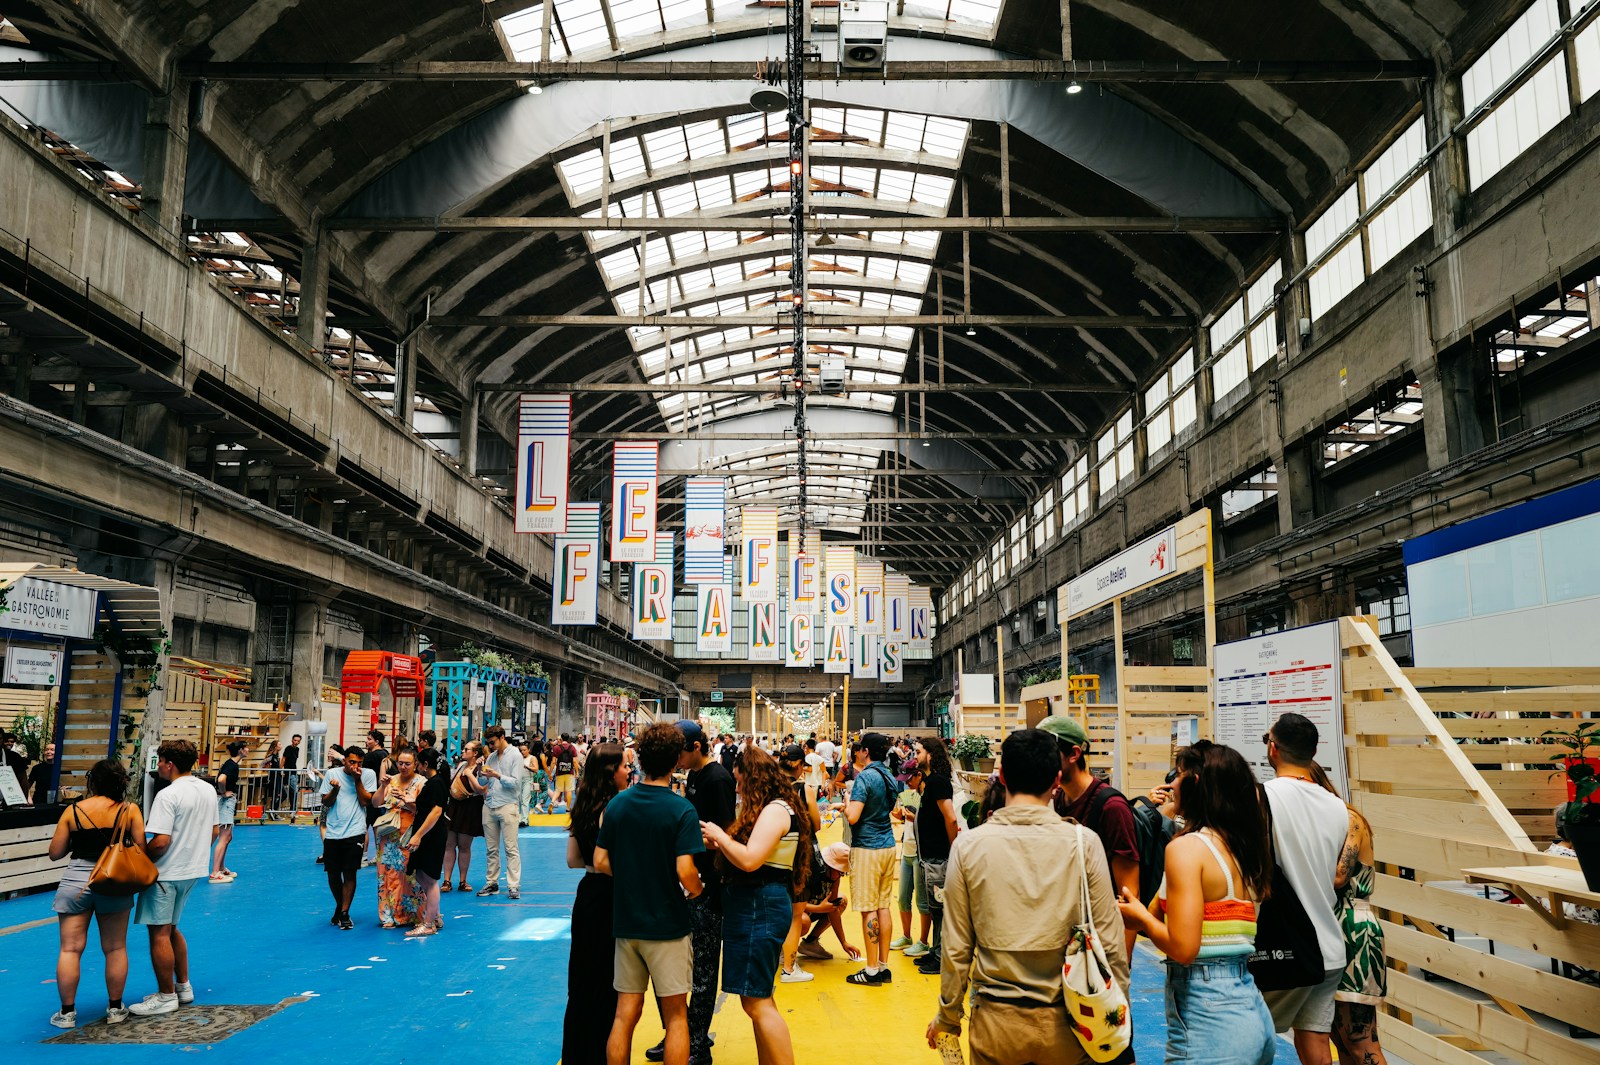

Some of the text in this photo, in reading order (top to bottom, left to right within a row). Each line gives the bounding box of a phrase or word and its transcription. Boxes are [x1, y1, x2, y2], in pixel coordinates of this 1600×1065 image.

[526, 441, 556, 511] L
[620, 482, 649, 542] E
[1096, 566, 1127, 591] Espace Ateliers
[26, 586, 54, 602] VALLÉE
[11, 600, 70, 620] GASTRONOMIE
[23, 620, 57, 630] FRANCE
[1271, 949, 1284, 960] 10
